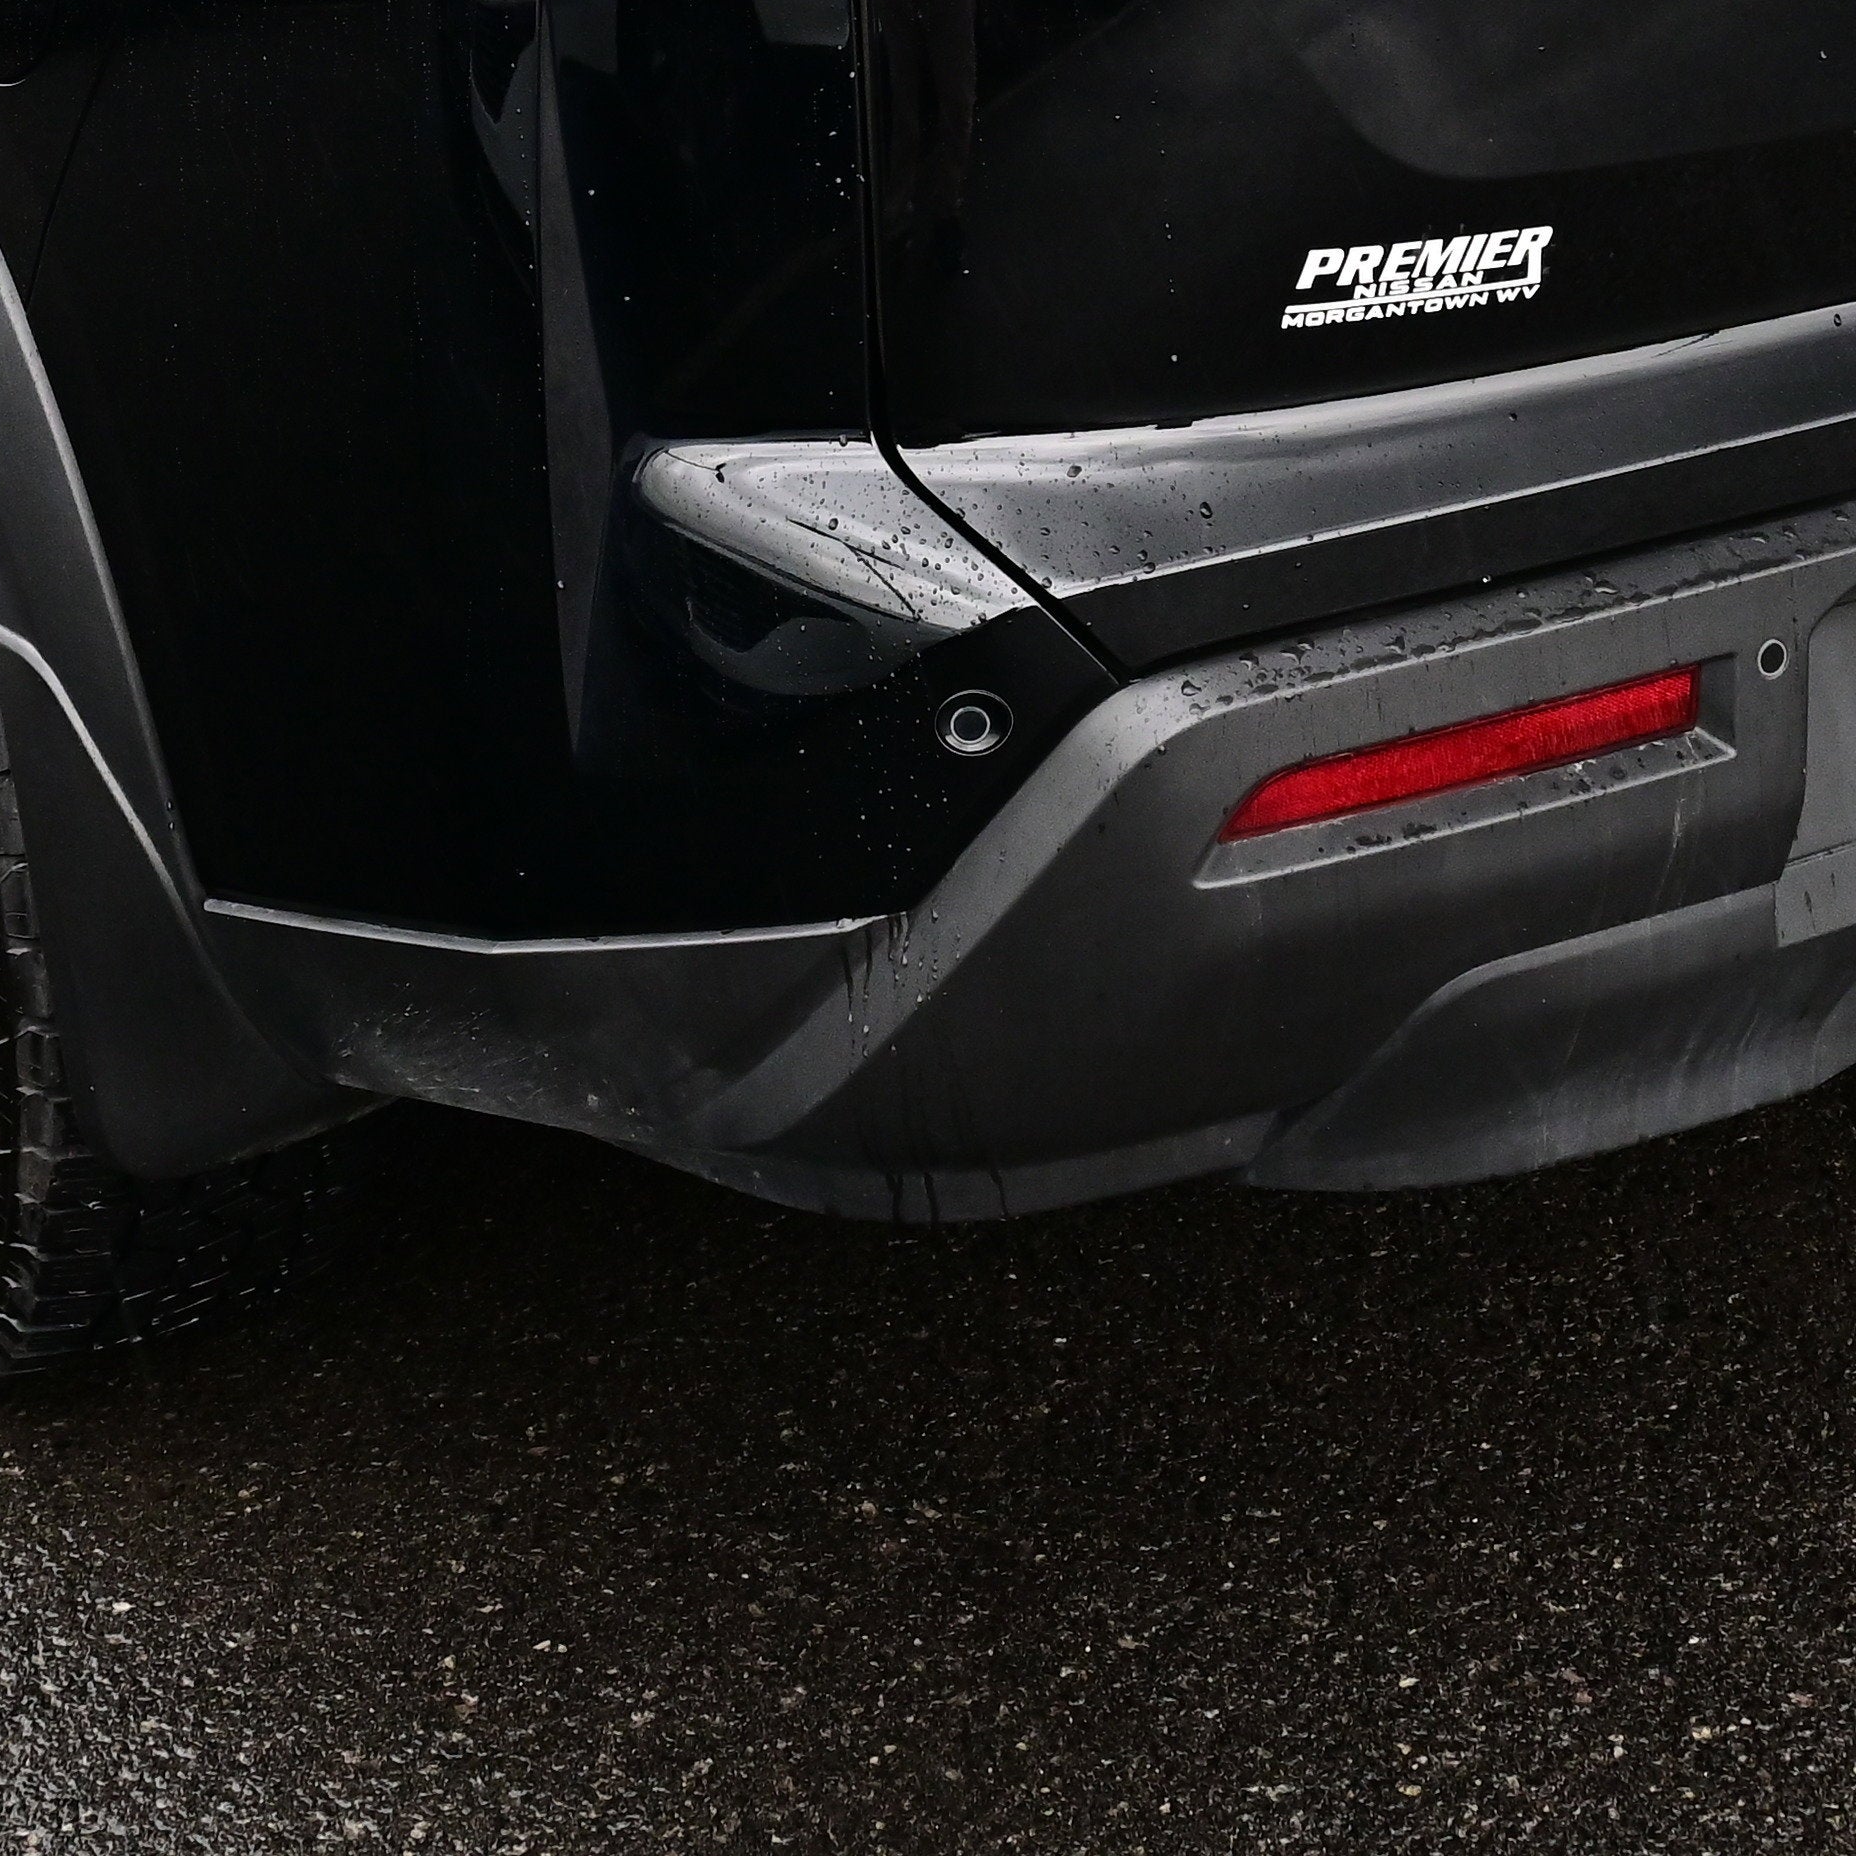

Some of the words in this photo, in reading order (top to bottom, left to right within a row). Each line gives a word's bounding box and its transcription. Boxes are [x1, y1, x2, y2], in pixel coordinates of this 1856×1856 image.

[1295, 225, 1553, 290] PREMIER
[1281, 291, 1489, 330] MORGANTOWN
[1496, 284, 1541, 303] WV
[1353, 270, 1484, 300] NISSAN
